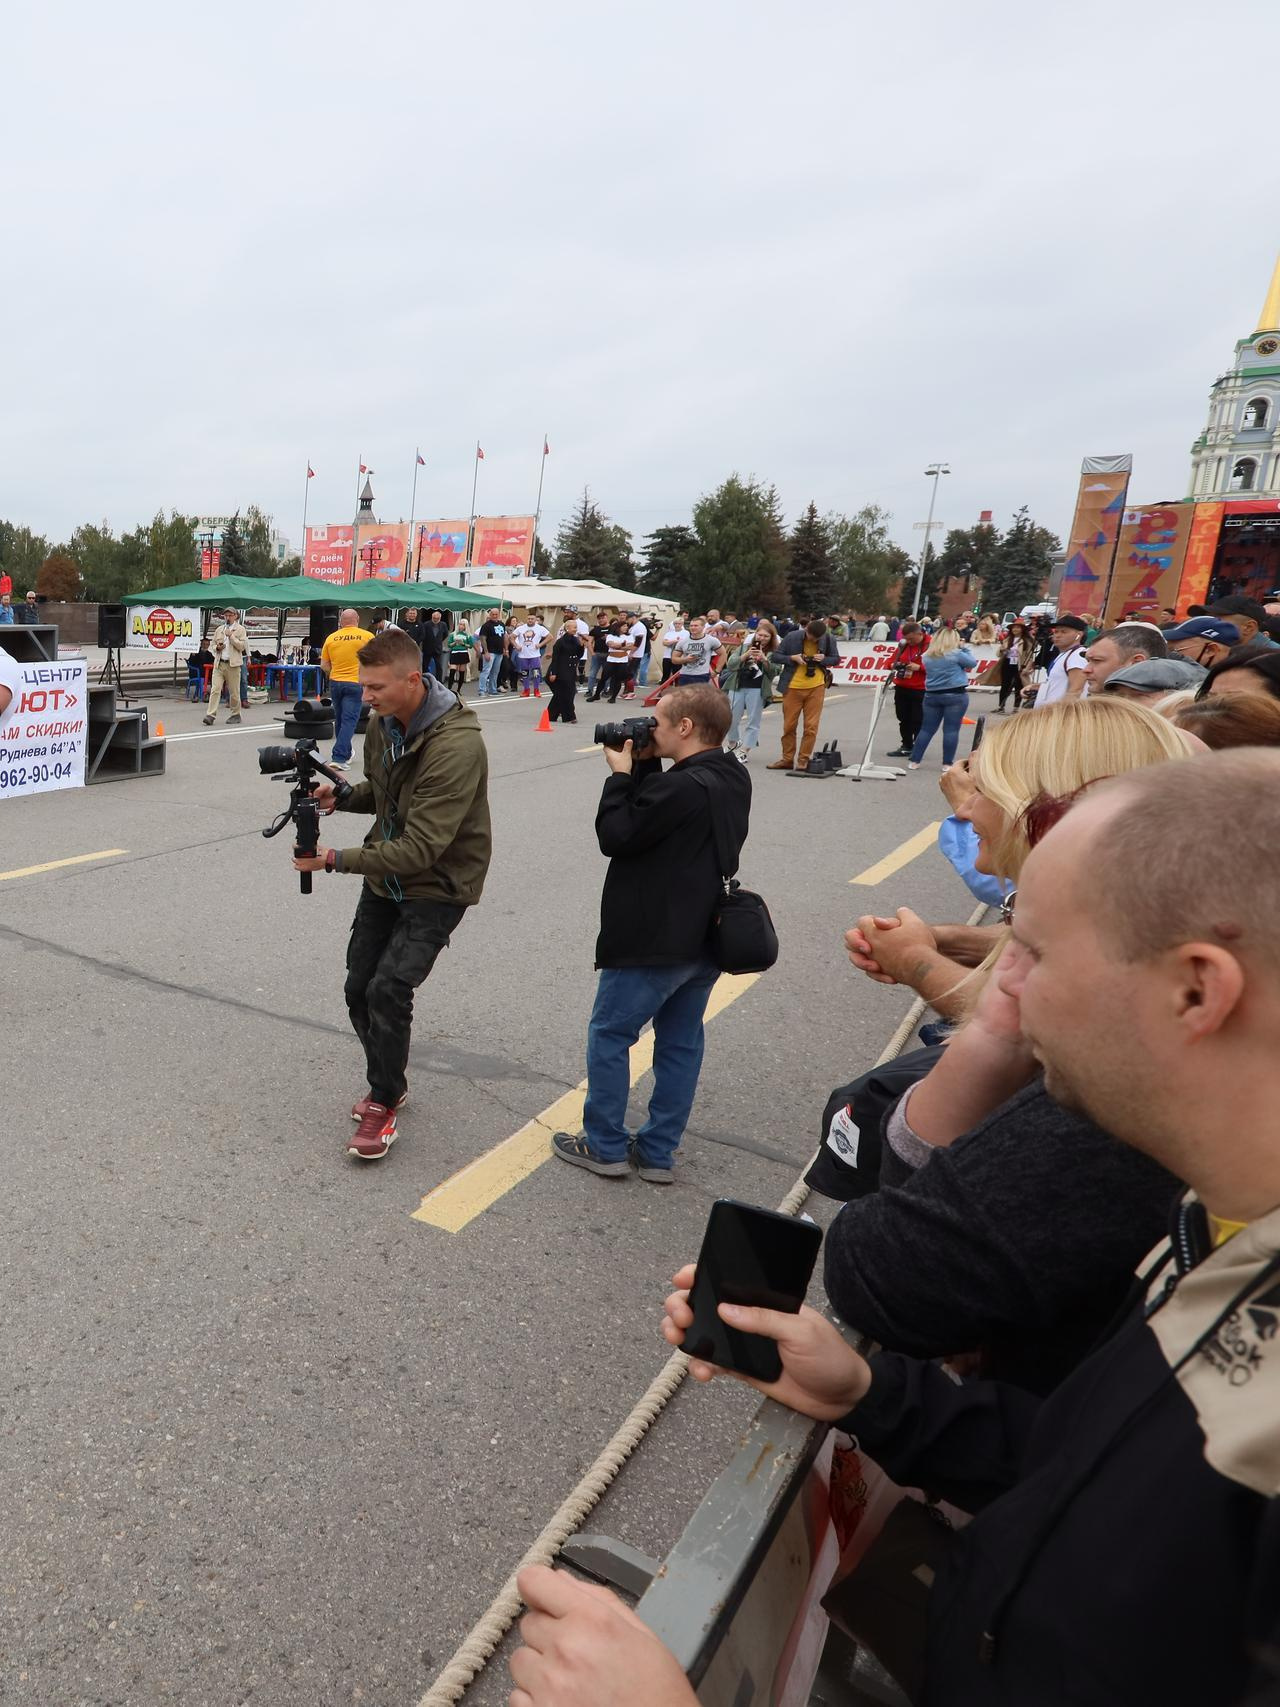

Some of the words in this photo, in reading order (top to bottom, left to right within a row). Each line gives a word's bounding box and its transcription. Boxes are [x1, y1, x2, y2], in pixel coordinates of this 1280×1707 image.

[311, 554, 318, 562] С
[320, 553, 343, 563] днём
[310, 567, 345, 576] города,
[827, 654, 892, 670] ЕЛОЙ
[848, 672, 888, 683] Тульс
[15, 690, 78, 713] ЮТ»
[26, 720, 83, 740] СКИДКИ!
[0, 745, 47, 763] Руднева
